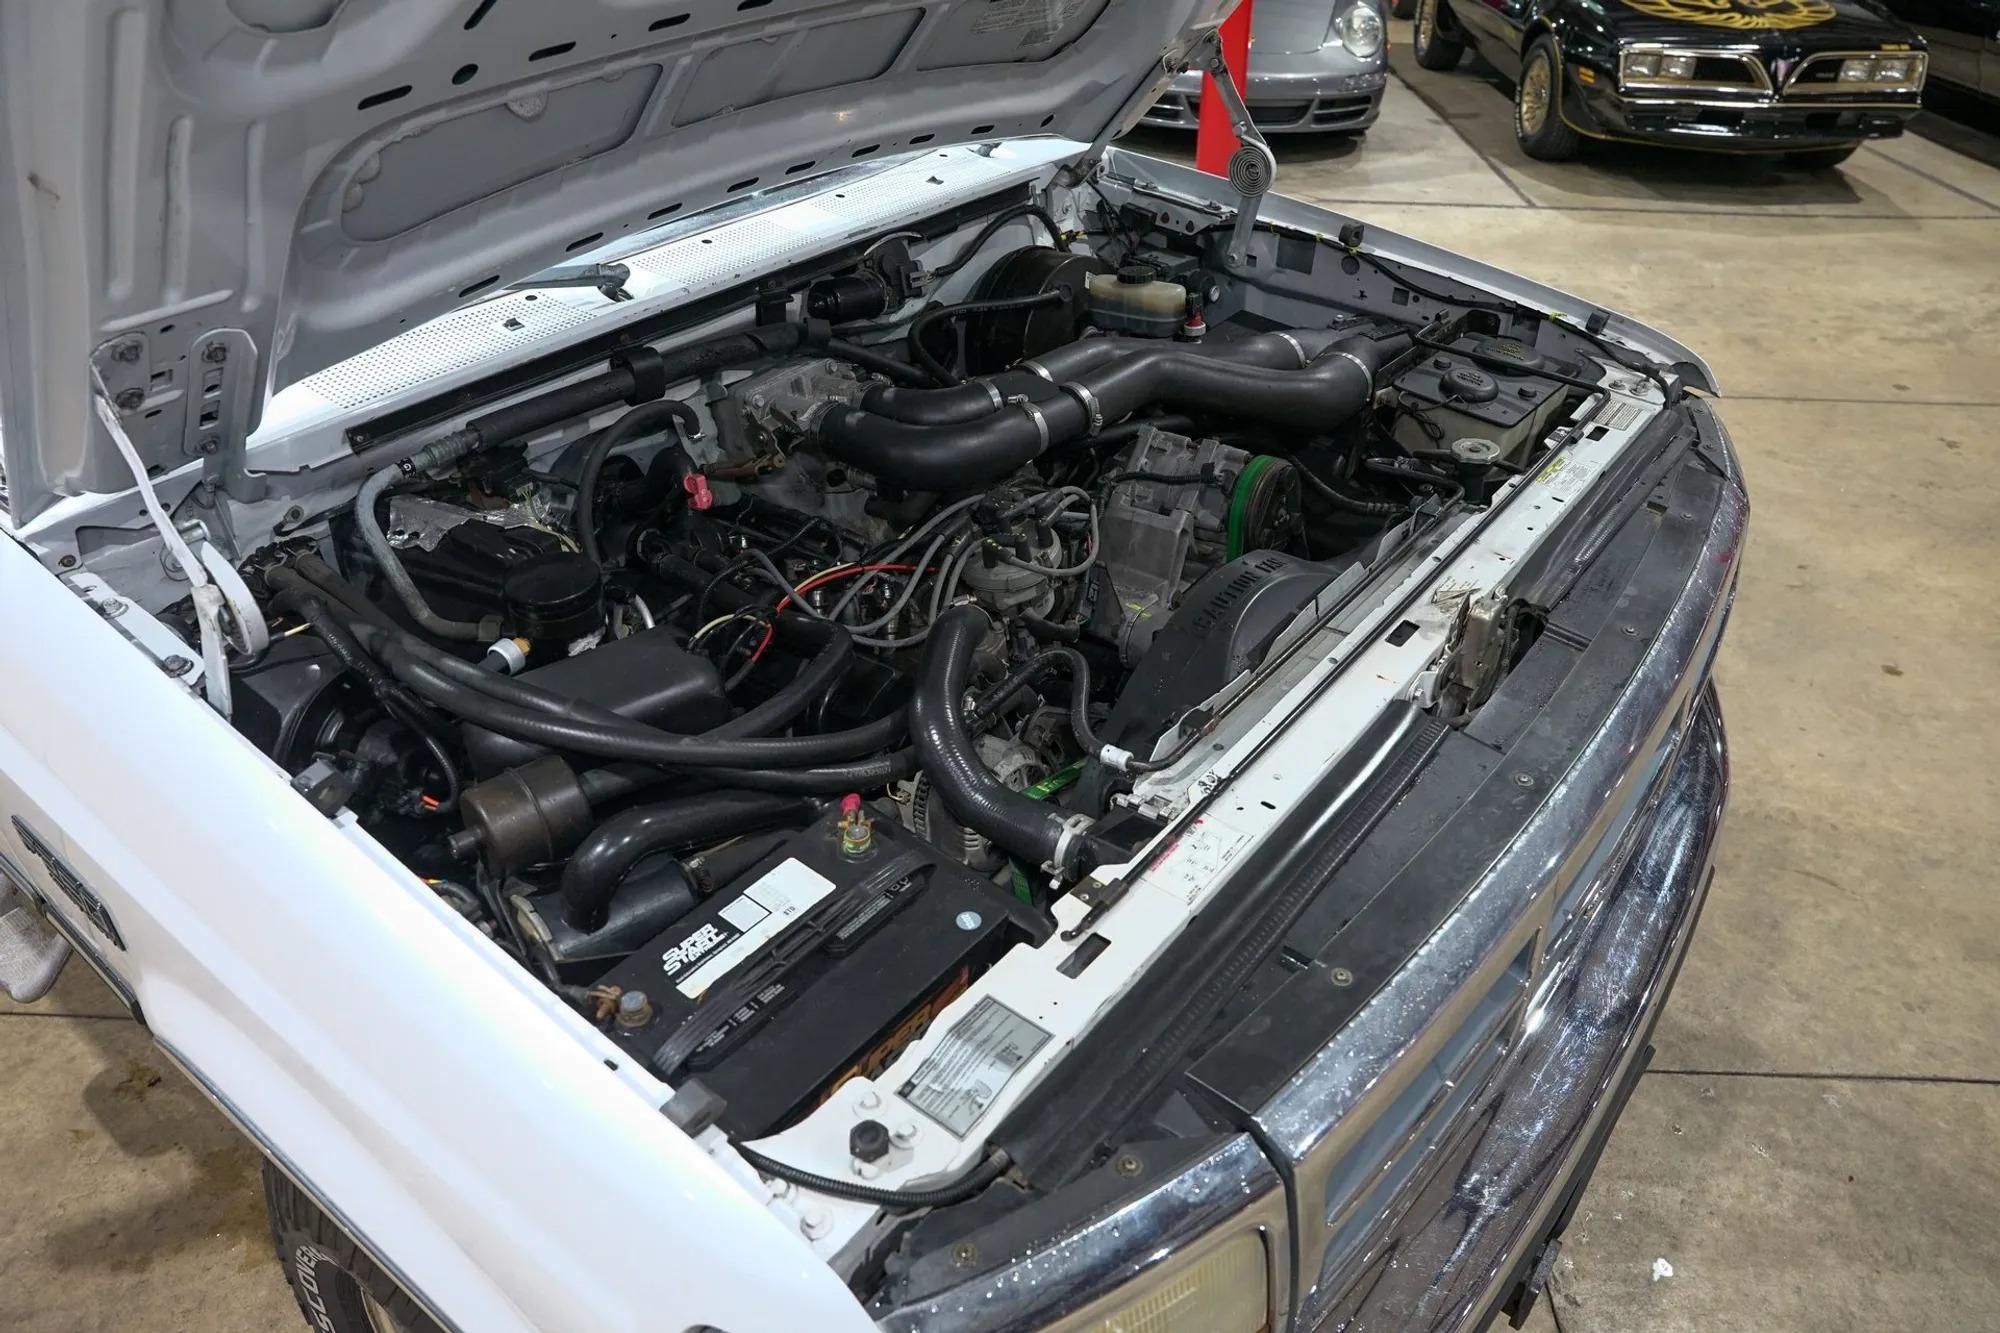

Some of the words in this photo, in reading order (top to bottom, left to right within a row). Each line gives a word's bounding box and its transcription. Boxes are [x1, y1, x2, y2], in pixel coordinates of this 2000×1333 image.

[1191, 571, 1259, 638] CAUTION
[1255, 558, 1285, 573] FAN
[662, 923, 716, 961] SUPER
[663, 927, 719, 976] START
